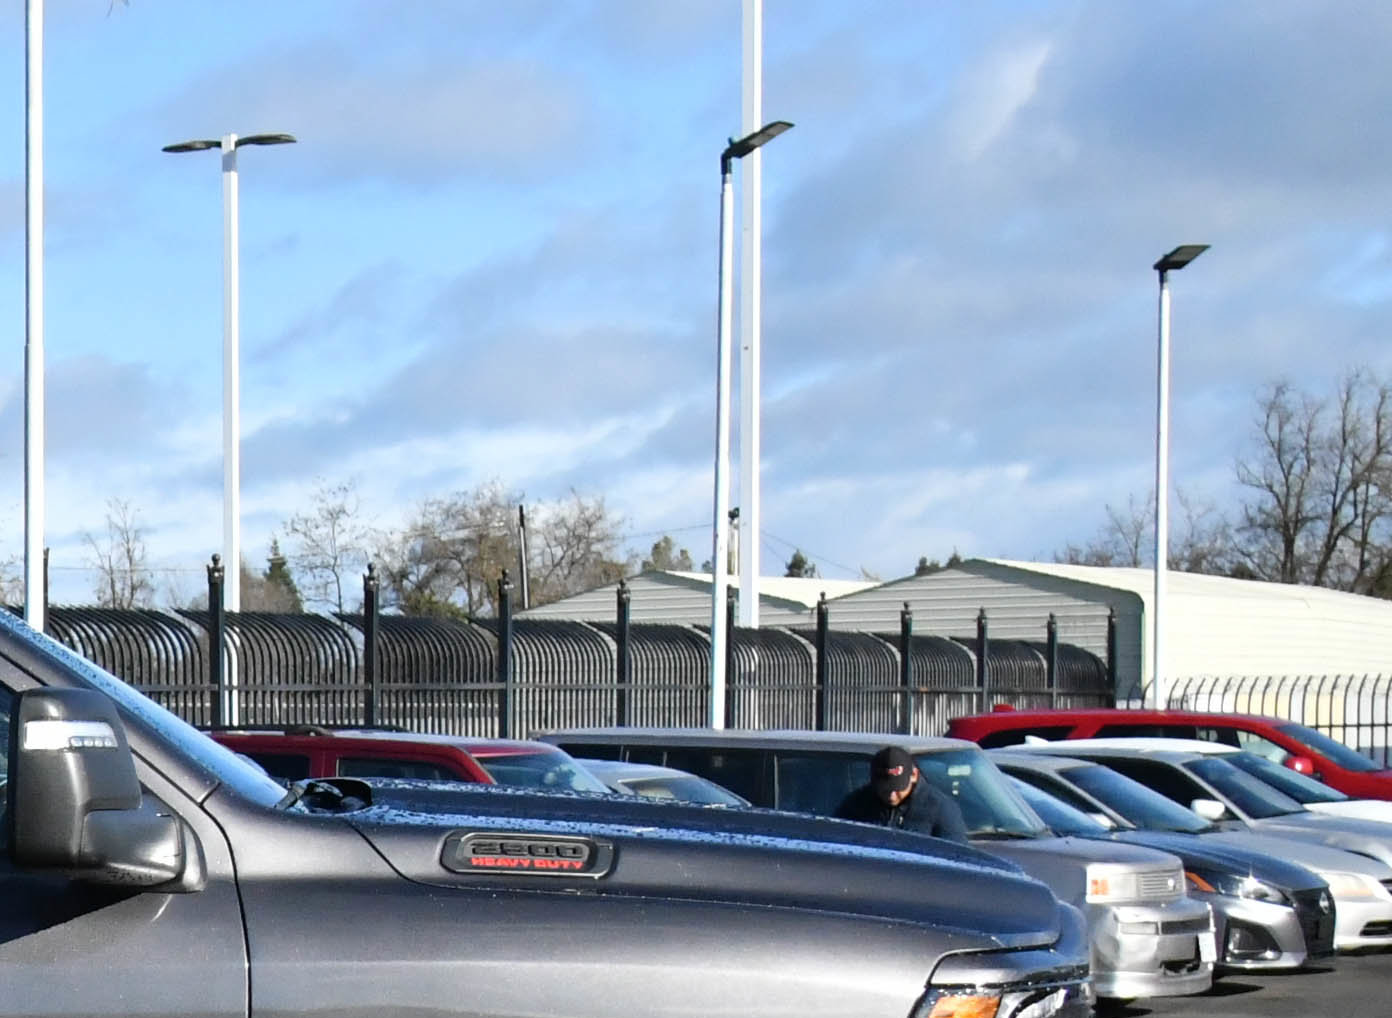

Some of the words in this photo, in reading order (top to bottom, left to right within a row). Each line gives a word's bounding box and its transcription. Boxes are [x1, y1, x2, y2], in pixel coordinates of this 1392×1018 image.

[471, 842, 584, 859] 2500
[470, 856, 531, 868] HEAVY
[533, 858, 584, 870] DUTY
